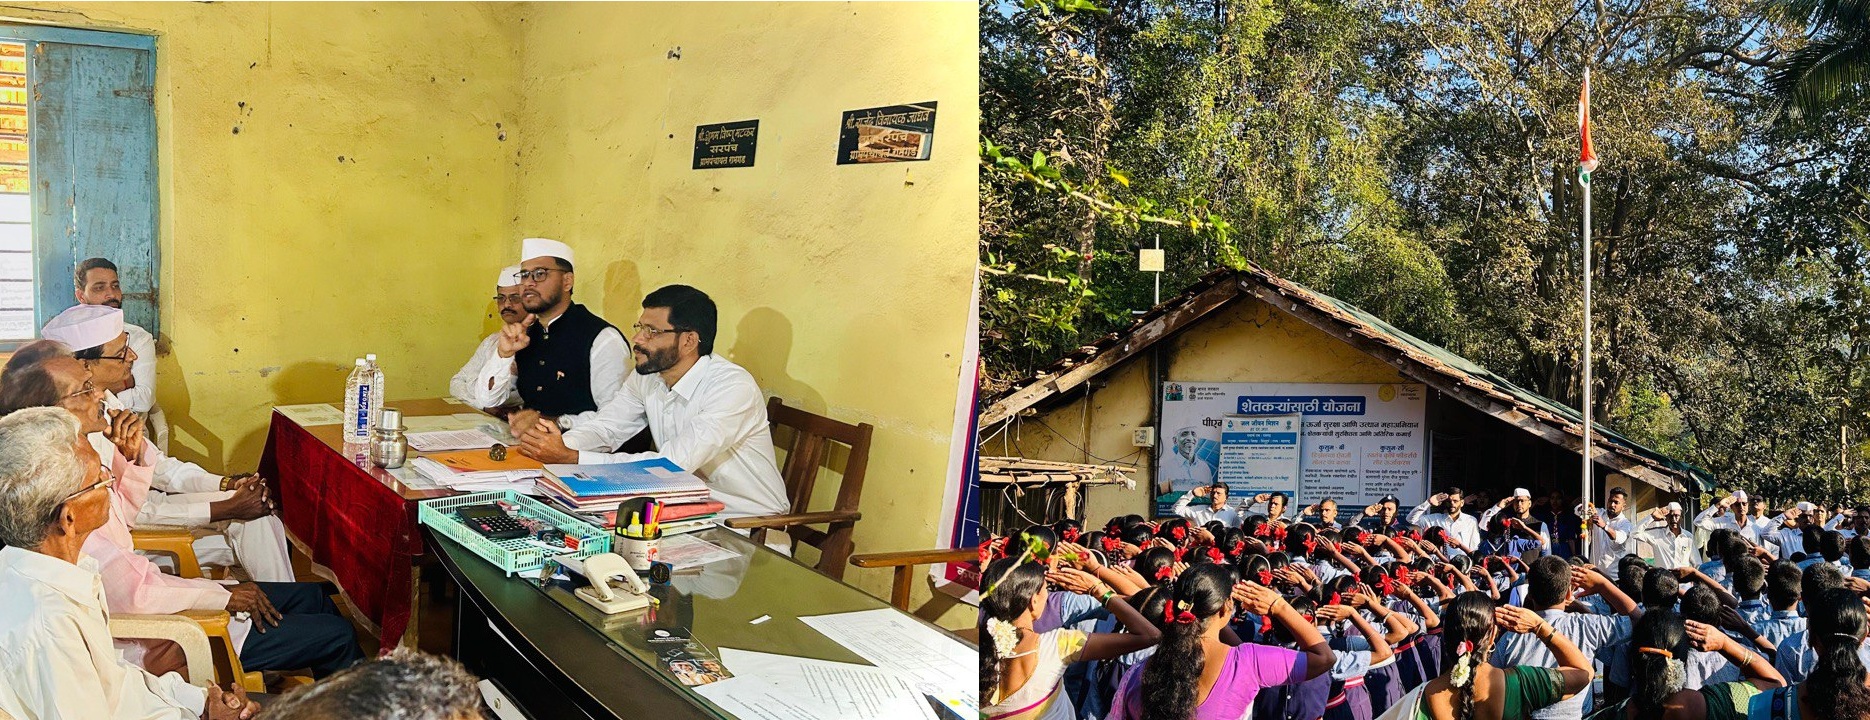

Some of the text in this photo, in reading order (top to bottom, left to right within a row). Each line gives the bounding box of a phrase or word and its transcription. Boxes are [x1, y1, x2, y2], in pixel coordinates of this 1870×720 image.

[710, 142, 739, 153] सरपंच
[1241, 398, 1361, 413] शेतकऱ्यांसाठी योजना
[1342, 420, 1358, 428] आणि
